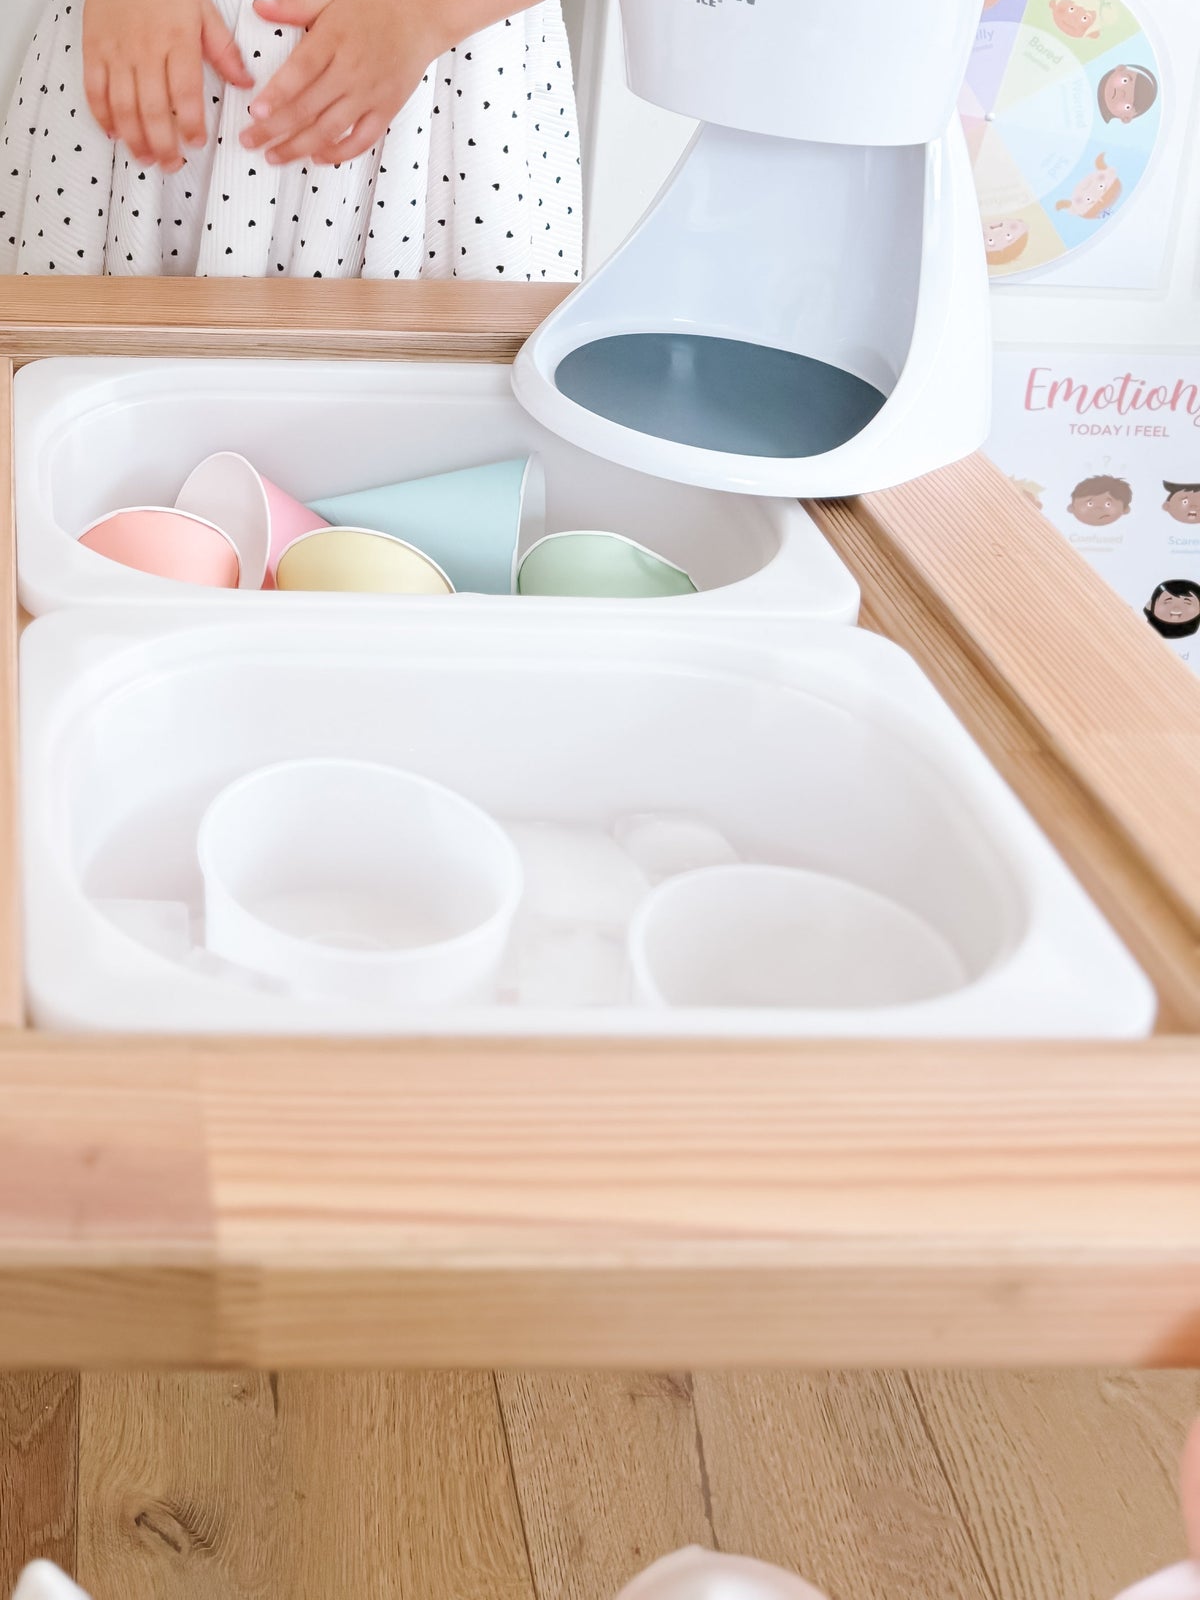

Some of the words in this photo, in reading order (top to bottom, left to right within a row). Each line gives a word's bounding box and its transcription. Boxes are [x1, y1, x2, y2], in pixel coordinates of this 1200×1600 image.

[1023, 367, 1200, 427] Emotion
[1068, 423, 1123, 437] TODAY
[1133, 424, 1170, 438] FEEL
